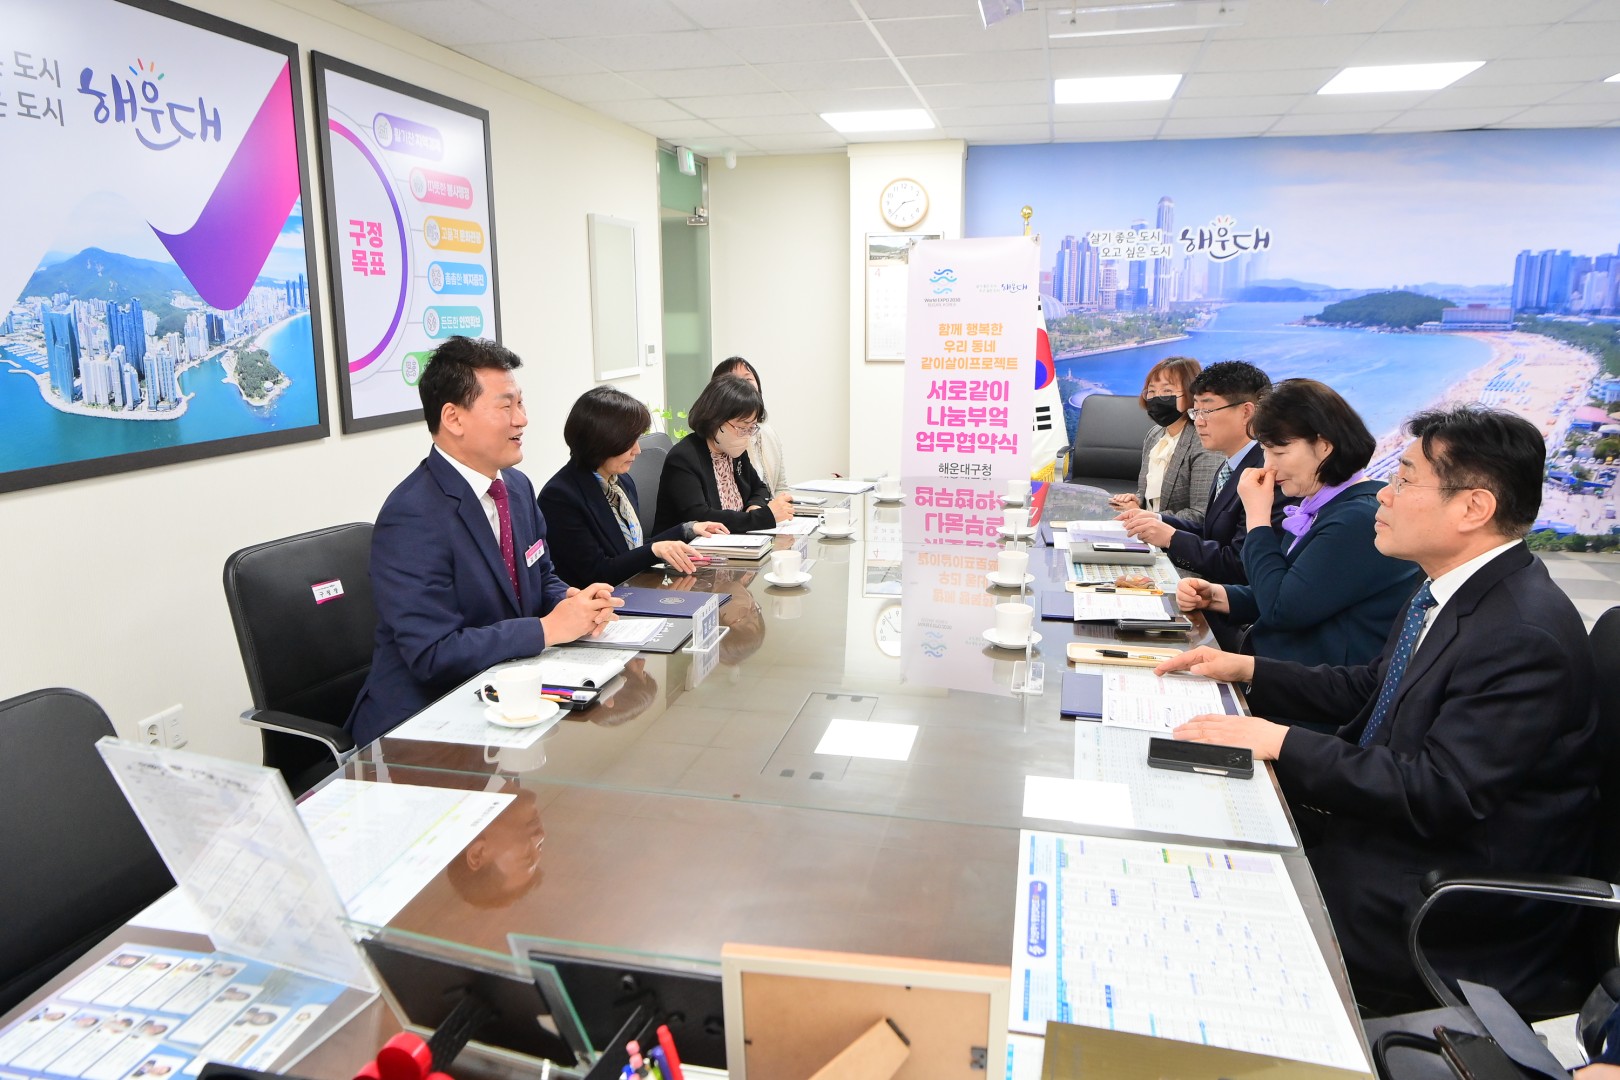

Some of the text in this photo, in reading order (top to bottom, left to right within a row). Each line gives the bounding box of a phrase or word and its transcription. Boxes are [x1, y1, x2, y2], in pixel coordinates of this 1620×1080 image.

[13, 50, 62, 88] 도시
[17, 91, 65, 127] 도시
[77, 67, 222, 151] 해운대
[349, 219, 383, 248] 구정
[1090, 231, 1161, 244] 살기 좋은 도시
[1179, 227, 1270, 259] 해운대
[351, 249, 385, 276] 목표
[1101, 246, 1171, 259] 오고 싶은 도시
[938, 322, 1003, 336] 함께 행복한
[943, 339, 996, 353] 우리 동네
[921, 356, 1018, 370] 같이살이프로젝트
[926, 380, 1009, 402] 서로같이
[926, 405, 1008, 428] 나눔부엌
[915, 431, 1018, 455] 업무협약식
[938, 462, 992, 476] 해운대구청
